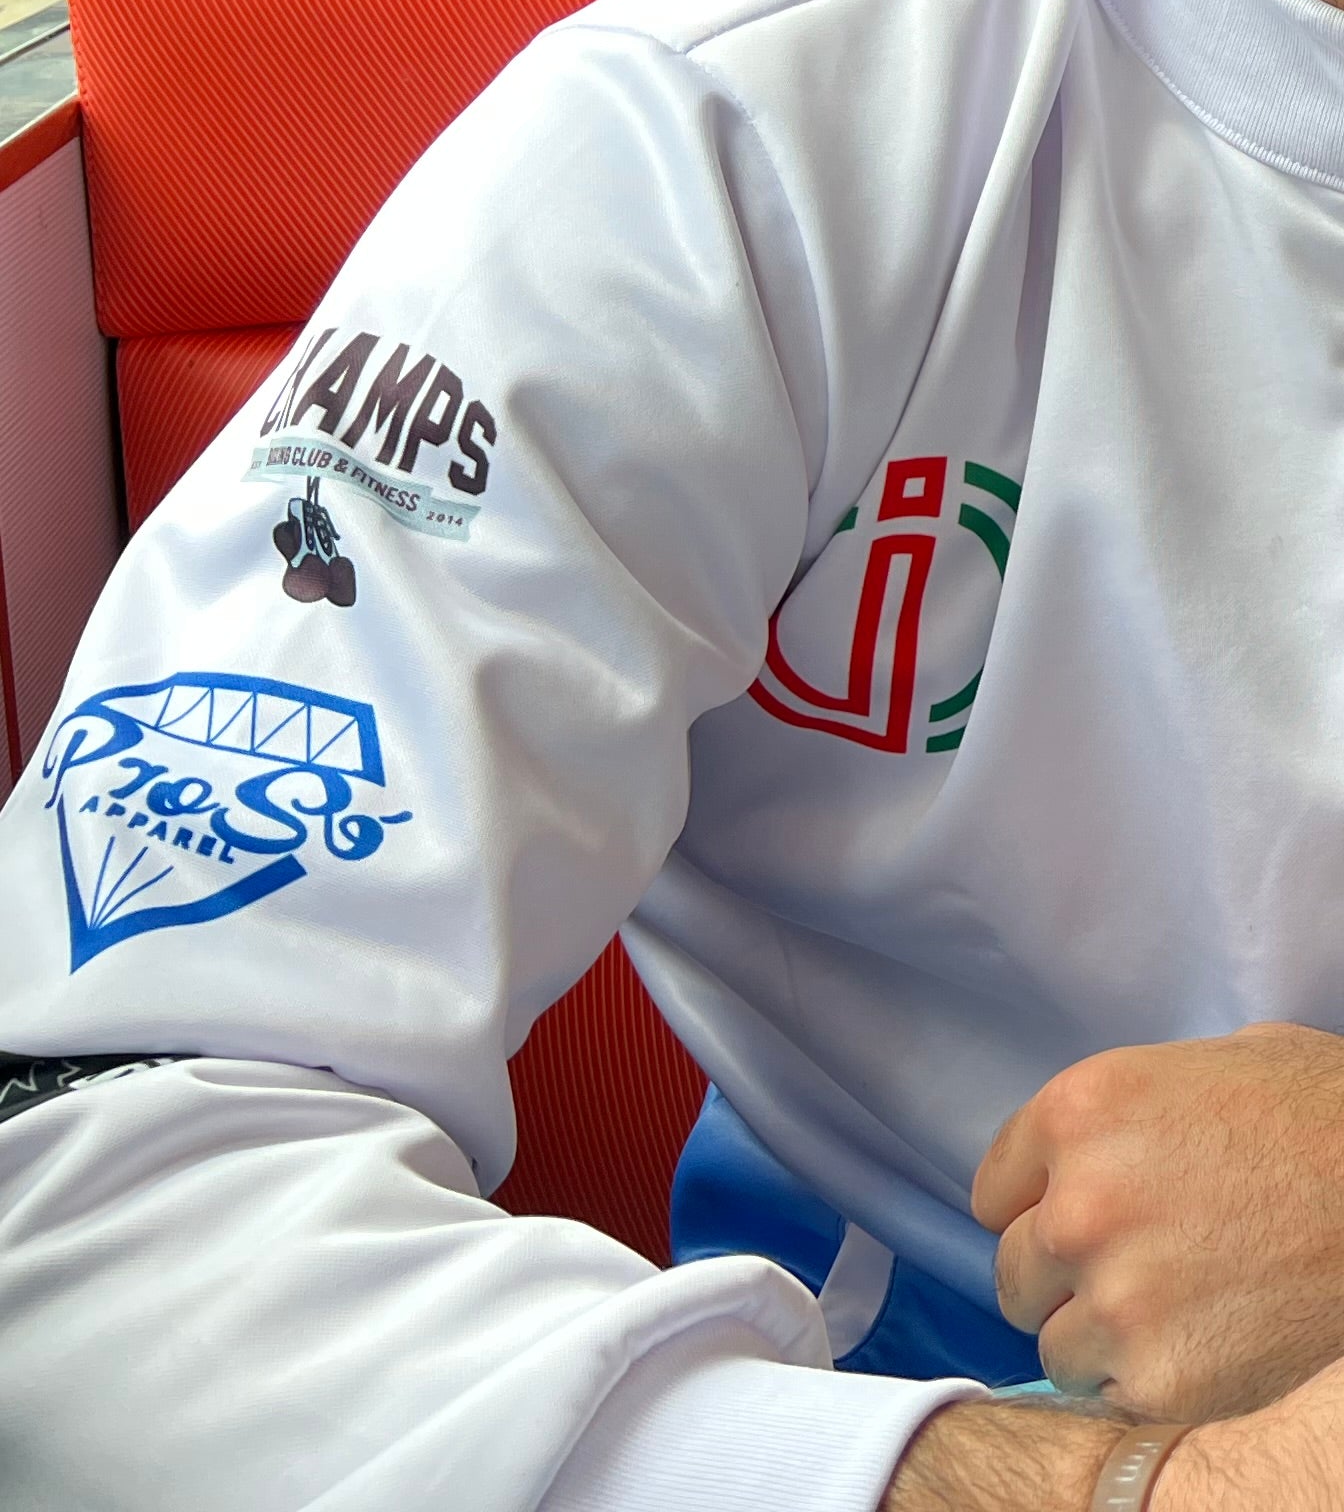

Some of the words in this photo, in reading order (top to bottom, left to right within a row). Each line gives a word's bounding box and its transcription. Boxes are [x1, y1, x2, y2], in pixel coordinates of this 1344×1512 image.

[291, 446, 333, 469] CLUB
[334, 458, 349, 473] &
[351, 466, 421, 512] FITNESS
[426, 511, 464, 528] 2014
[79, 795, 235, 865] APPAREL
